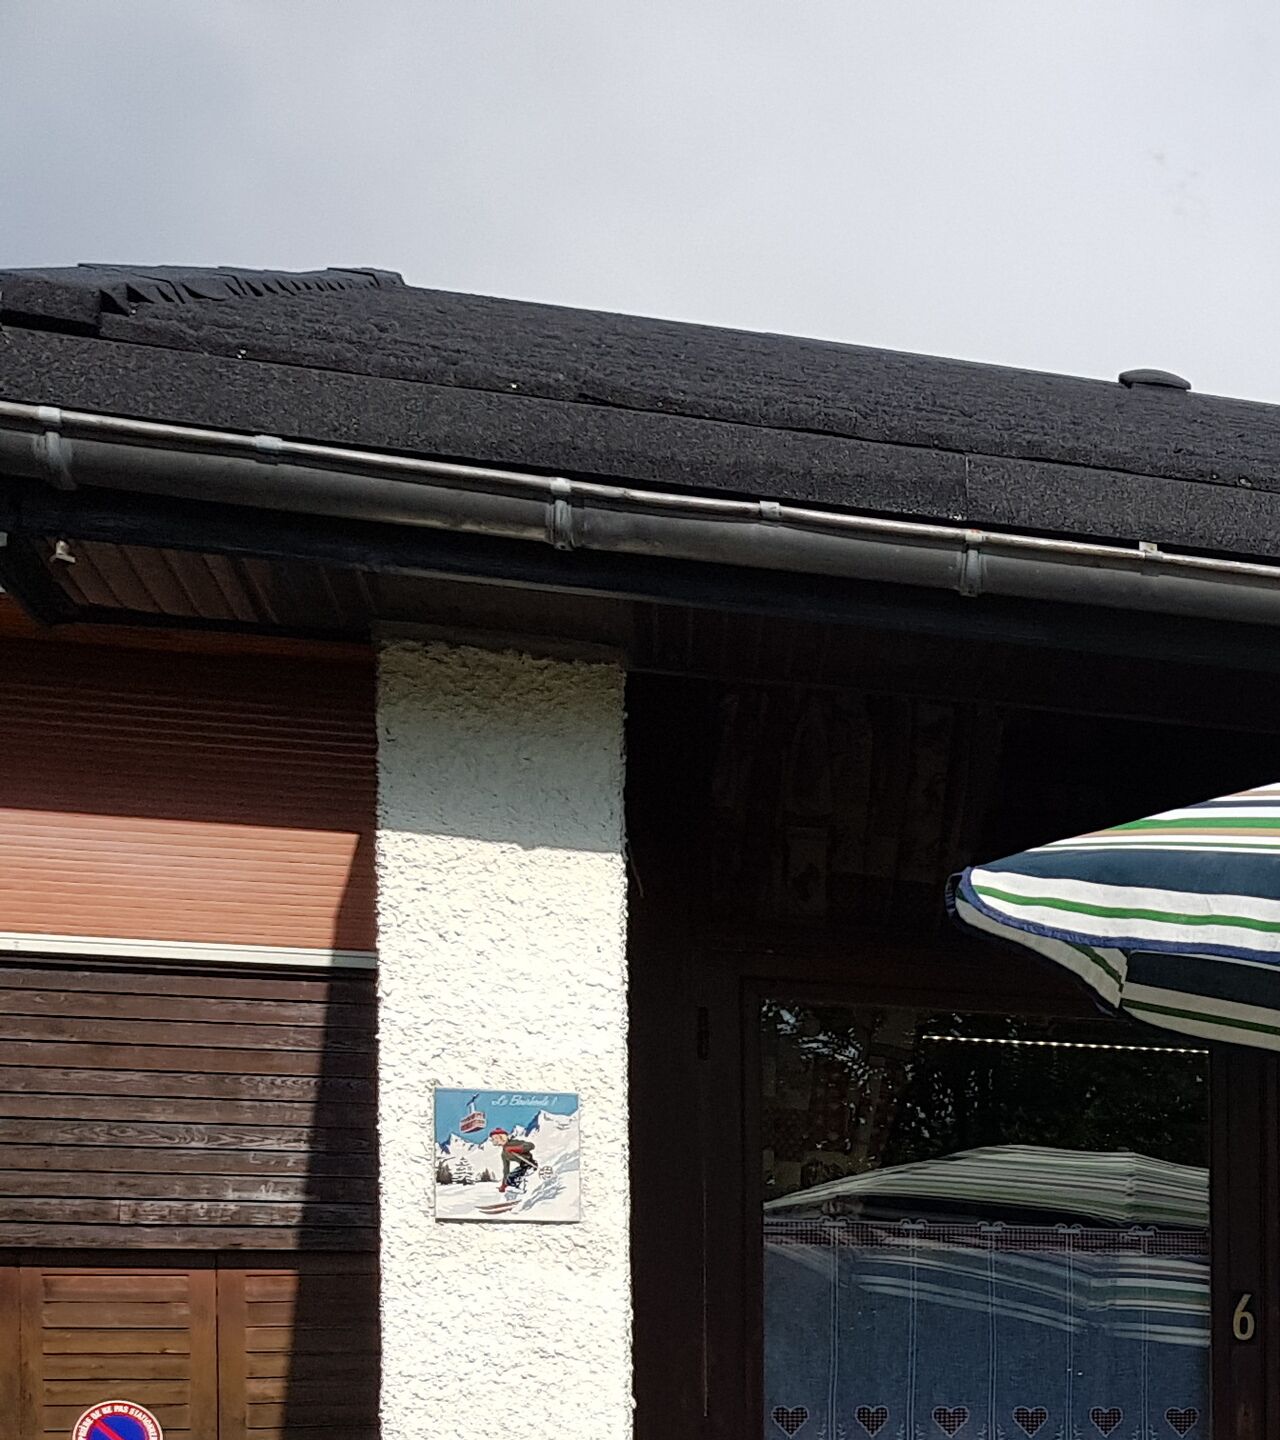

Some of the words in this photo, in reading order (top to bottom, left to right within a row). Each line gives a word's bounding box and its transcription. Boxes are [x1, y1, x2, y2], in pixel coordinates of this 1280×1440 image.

[1233, 1293, 1255, 1341] 6
[90, 1409, 103, 1420] DE
[101, 1405, 113, 1414] NE
[113, 1404, 129, 1413] PAS
